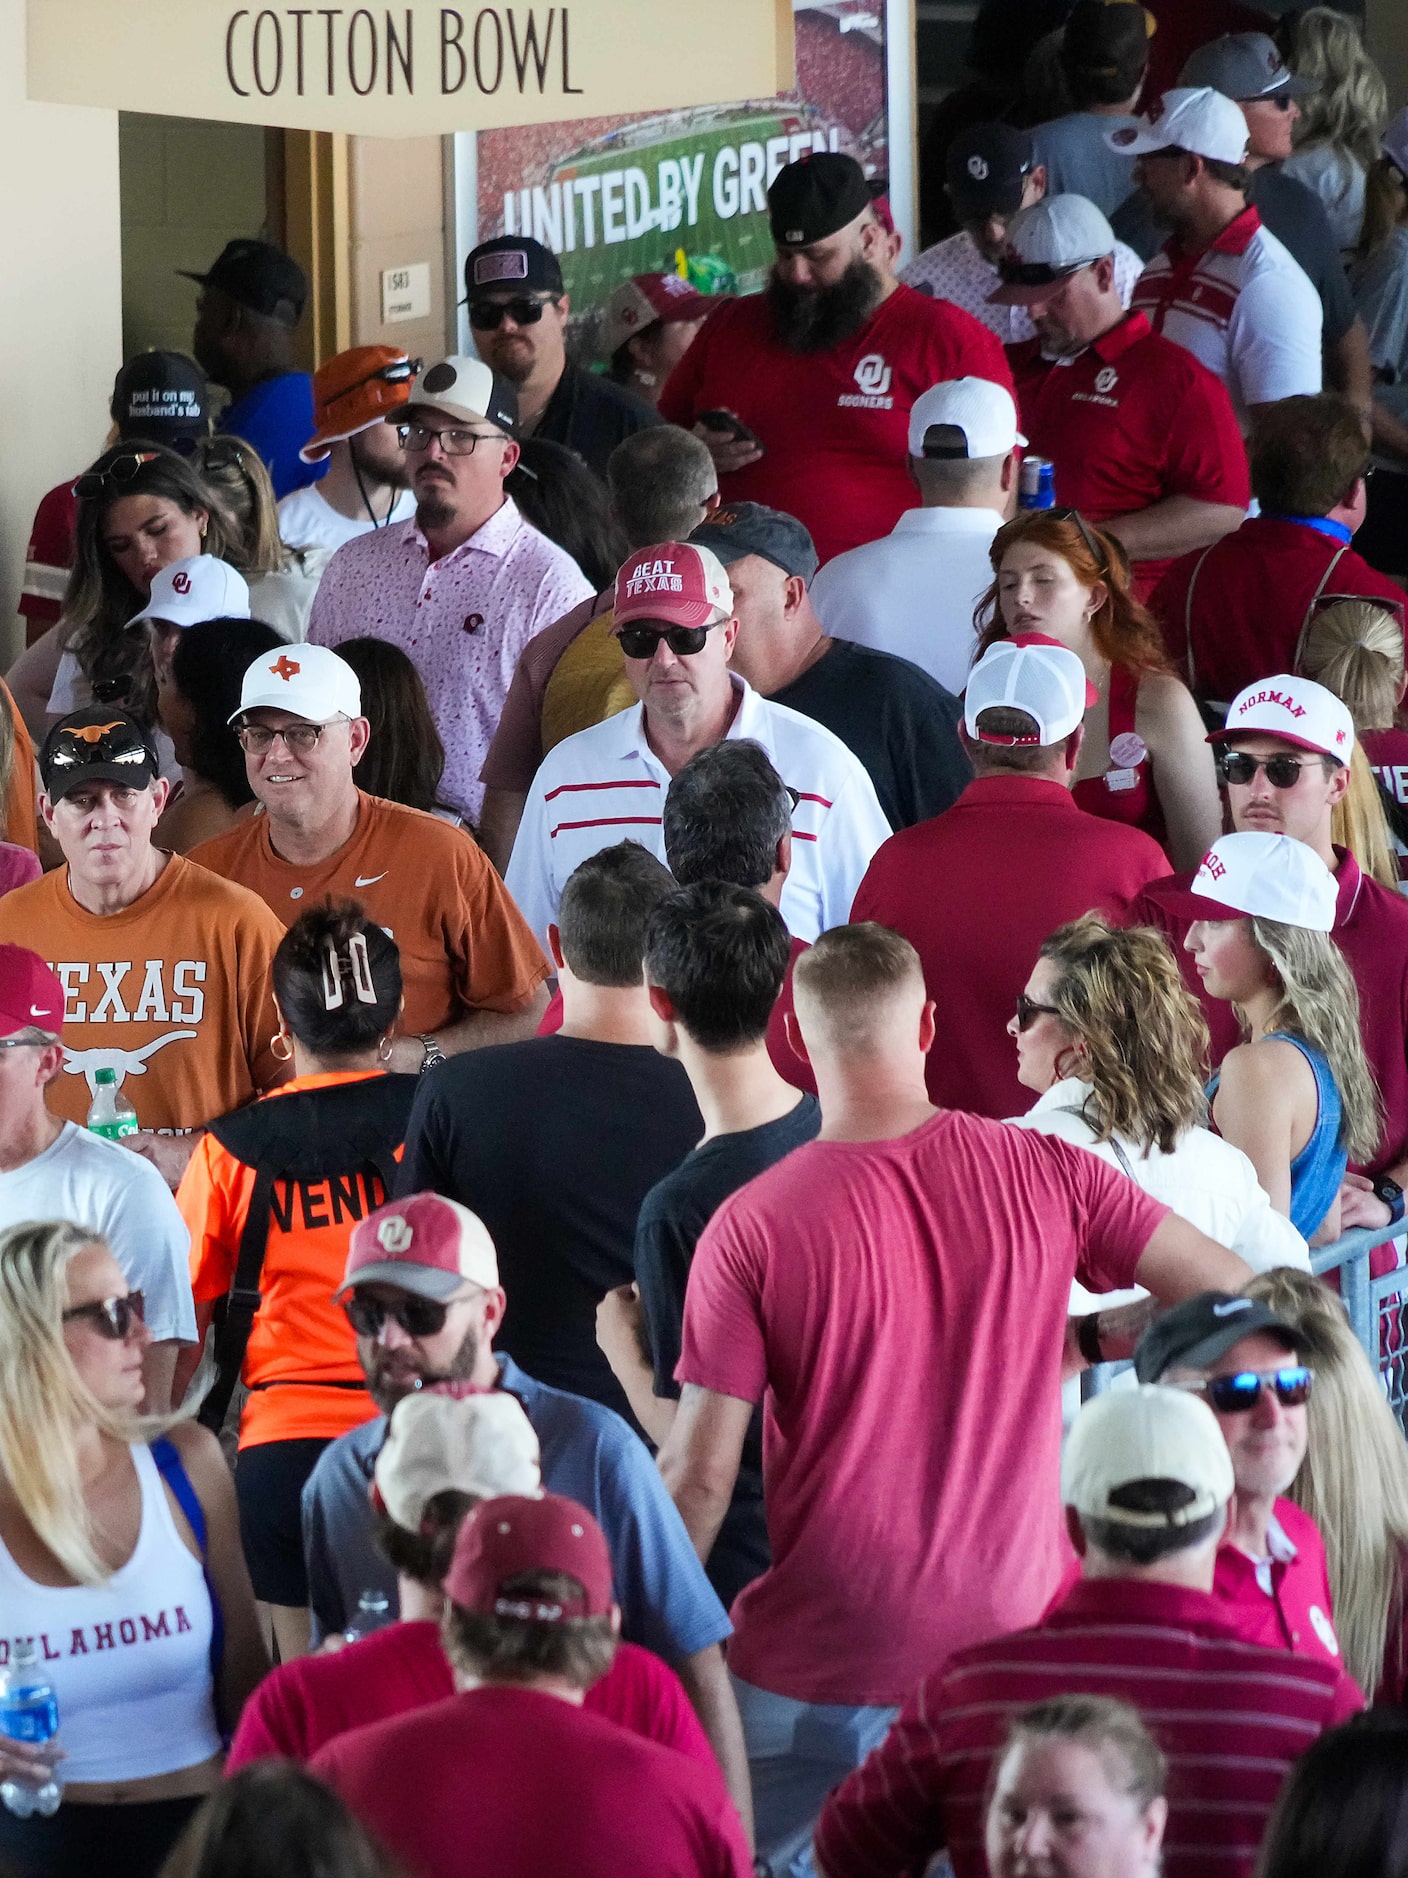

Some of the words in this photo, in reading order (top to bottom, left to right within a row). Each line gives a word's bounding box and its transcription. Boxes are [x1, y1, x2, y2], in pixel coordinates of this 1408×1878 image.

[225, 8, 414, 97] COTTON
[440, 7, 584, 96] BOWL
[503, 166, 651, 256] UNITED
[657, 152, 706, 233] BY
[713, 127, 839, 220] GRE
[854, 353, 892, 396] OU
[129, 402, 184, 418] husband's
[132, 390, 150, 405] put
[152, 388, 160, 402] it
[162, 390, 178, 402] on
[179, 390, 195, 406] my
[632, 559, 675, 579] BEAT
[626, 576, 683, 599] TEXAS
[1238, 690, 1308, 719] NORMAN
[51, 960, 208, 1024] EXAS
